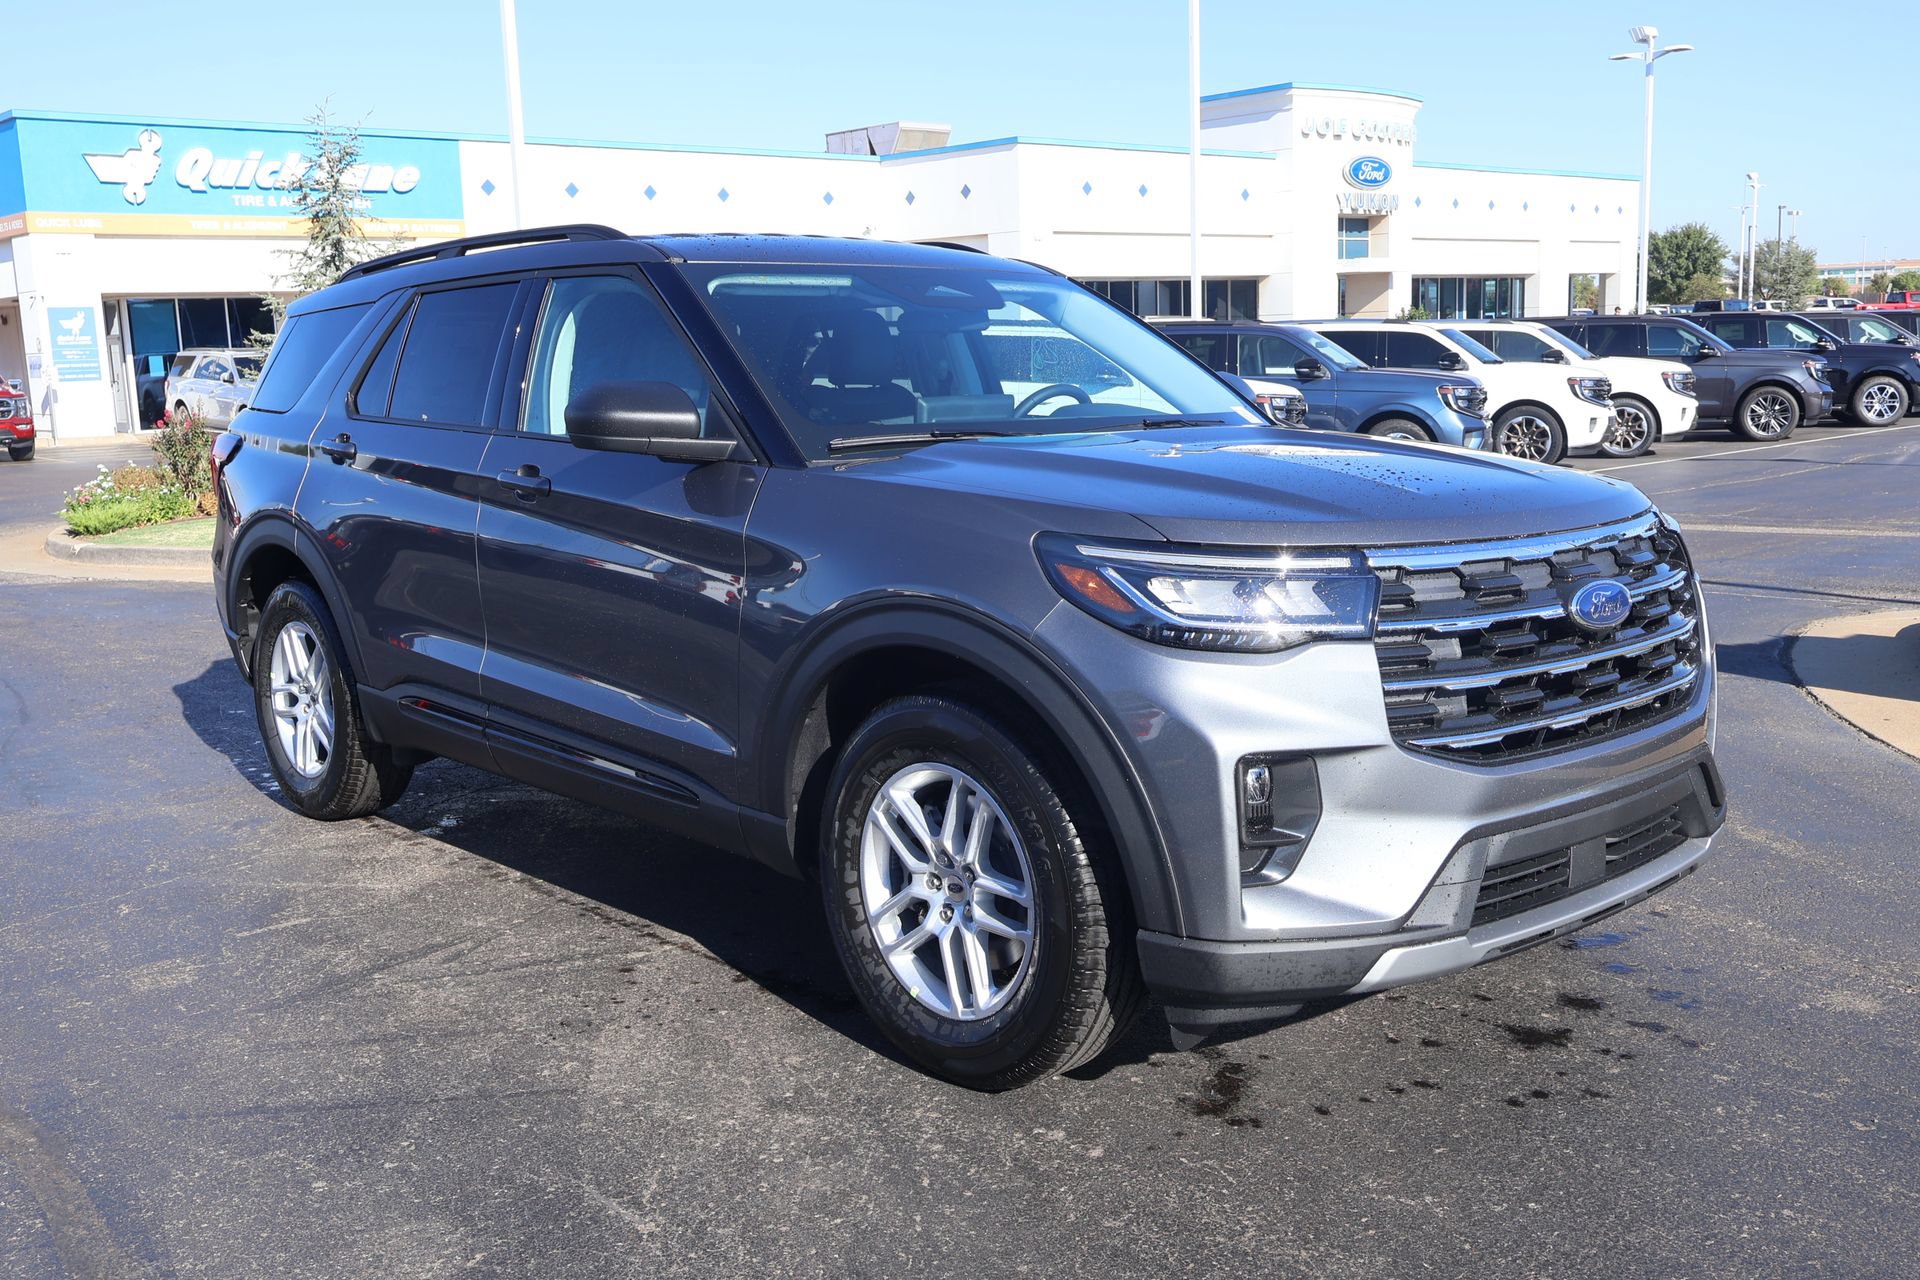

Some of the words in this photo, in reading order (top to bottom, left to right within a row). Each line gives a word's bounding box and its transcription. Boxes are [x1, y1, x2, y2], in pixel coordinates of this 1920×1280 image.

[232, 195, 265, 207] TIRE
[1341, 192, 1399, 212] YUKON
[1590, 590, 1623, 619] Ford
